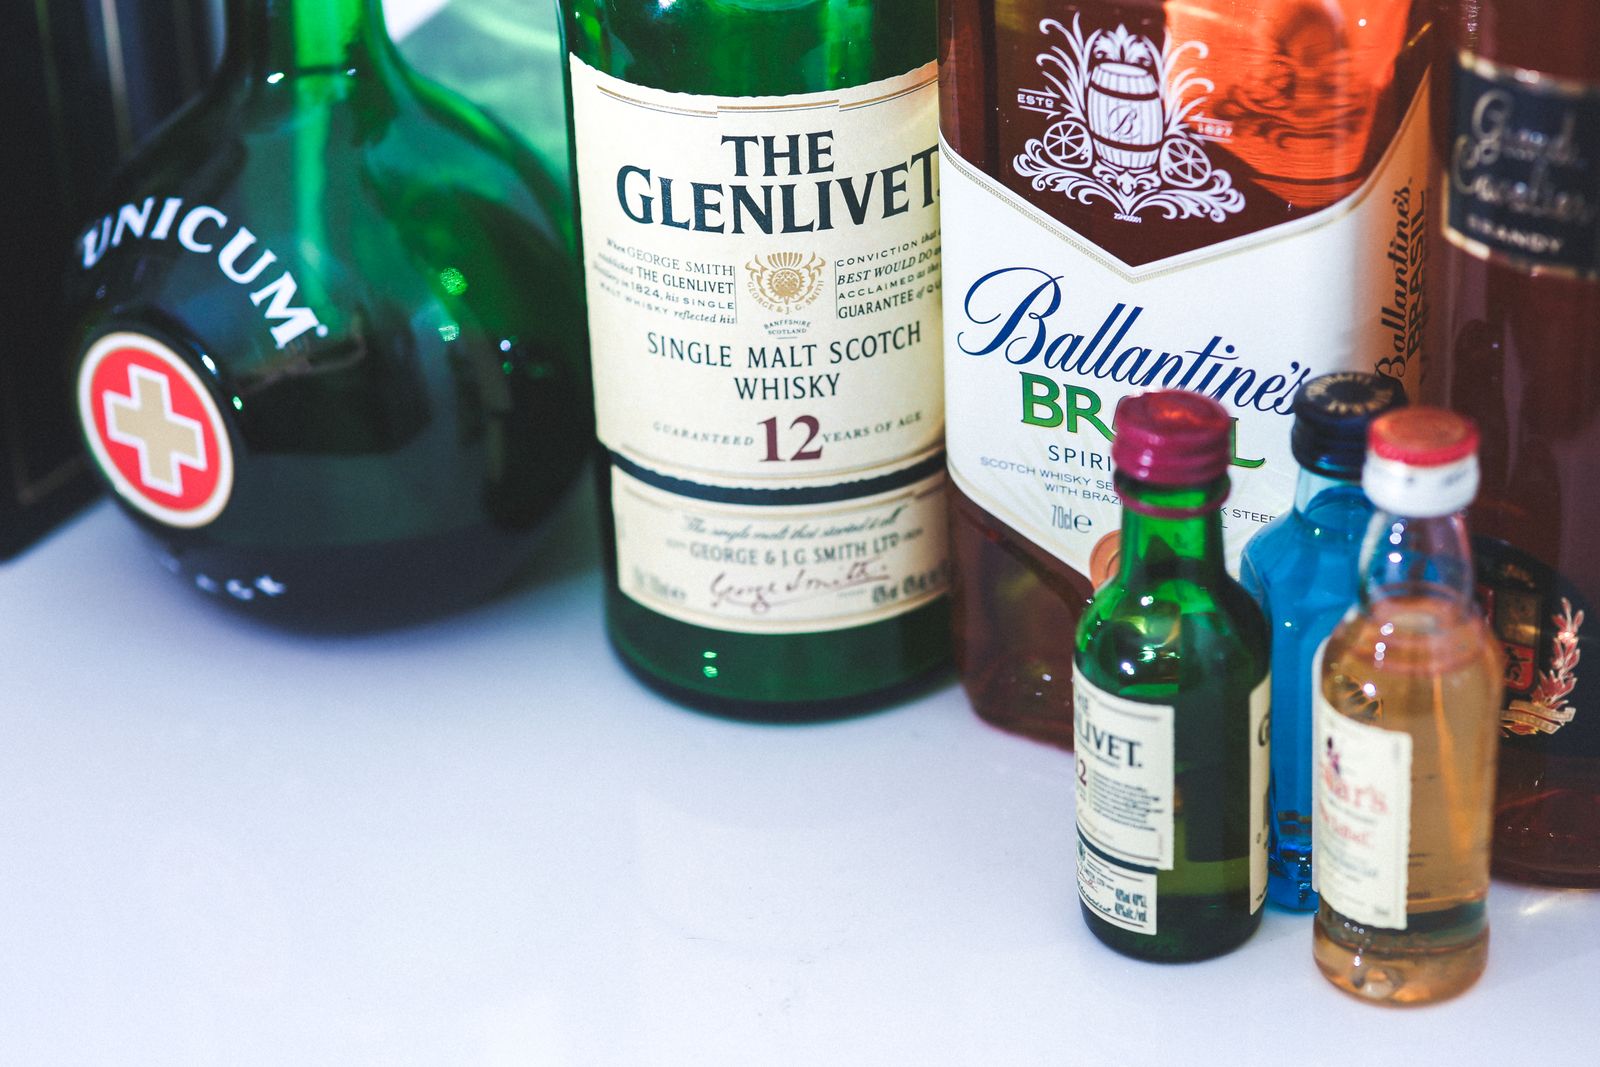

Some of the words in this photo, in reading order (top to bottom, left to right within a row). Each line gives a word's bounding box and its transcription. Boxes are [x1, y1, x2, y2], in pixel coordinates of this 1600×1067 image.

[720, 129, 835, 178] THE
[626, 245, 681, 271] GEORGE
[685, 261, 734, 277] SMITH
[836, 239, 919, 268] CONVICTION
[636, 265, 659, 284] THE
[662, 273, 734, 295] GLENLIVET
[837, 269, 873, 286] BEST
[874, 256, 917, 277] WOULD
[837, 273, 915, 300] ACCLAIMED
[1406, 190, 1425, 362] BRASIL
[674, 308, 717, 323] reflected
[719, 315, 736, 325] his
[683, 297, 735, 310] SINGLE
[837, 288, 915, 320] GUARANTEE
[646, 331, 733, 368] SINGLE
[747, 343, 819, 369] MALT
[829, 320, 922, 365] SCOTCH
[957, 266, 1312, 416] Ballantine's
[733, 372, 841, 401] WHISKY
[1018, 370, 1267, 470] BRL
[652, 420, 755, 448] GUARANTEED
[757, 414, 825, 464] 12
[822, 425, 871, 445] YEARS
[874, 420, 894, 435] OF
[897, 410, 923, 429] AGE
[979, 456, 1036, 476] SCOTCH
[1039, 469, 1092, 487] WHISKY
[1047, 444, 1112, 472] SPIRI
[1044, 482, 1079, 497] WITH
[689, 541, 759, 565] GEORGE
[813, 541, 868, 564] SMITH
[872, 531, 900, 554] LTD
